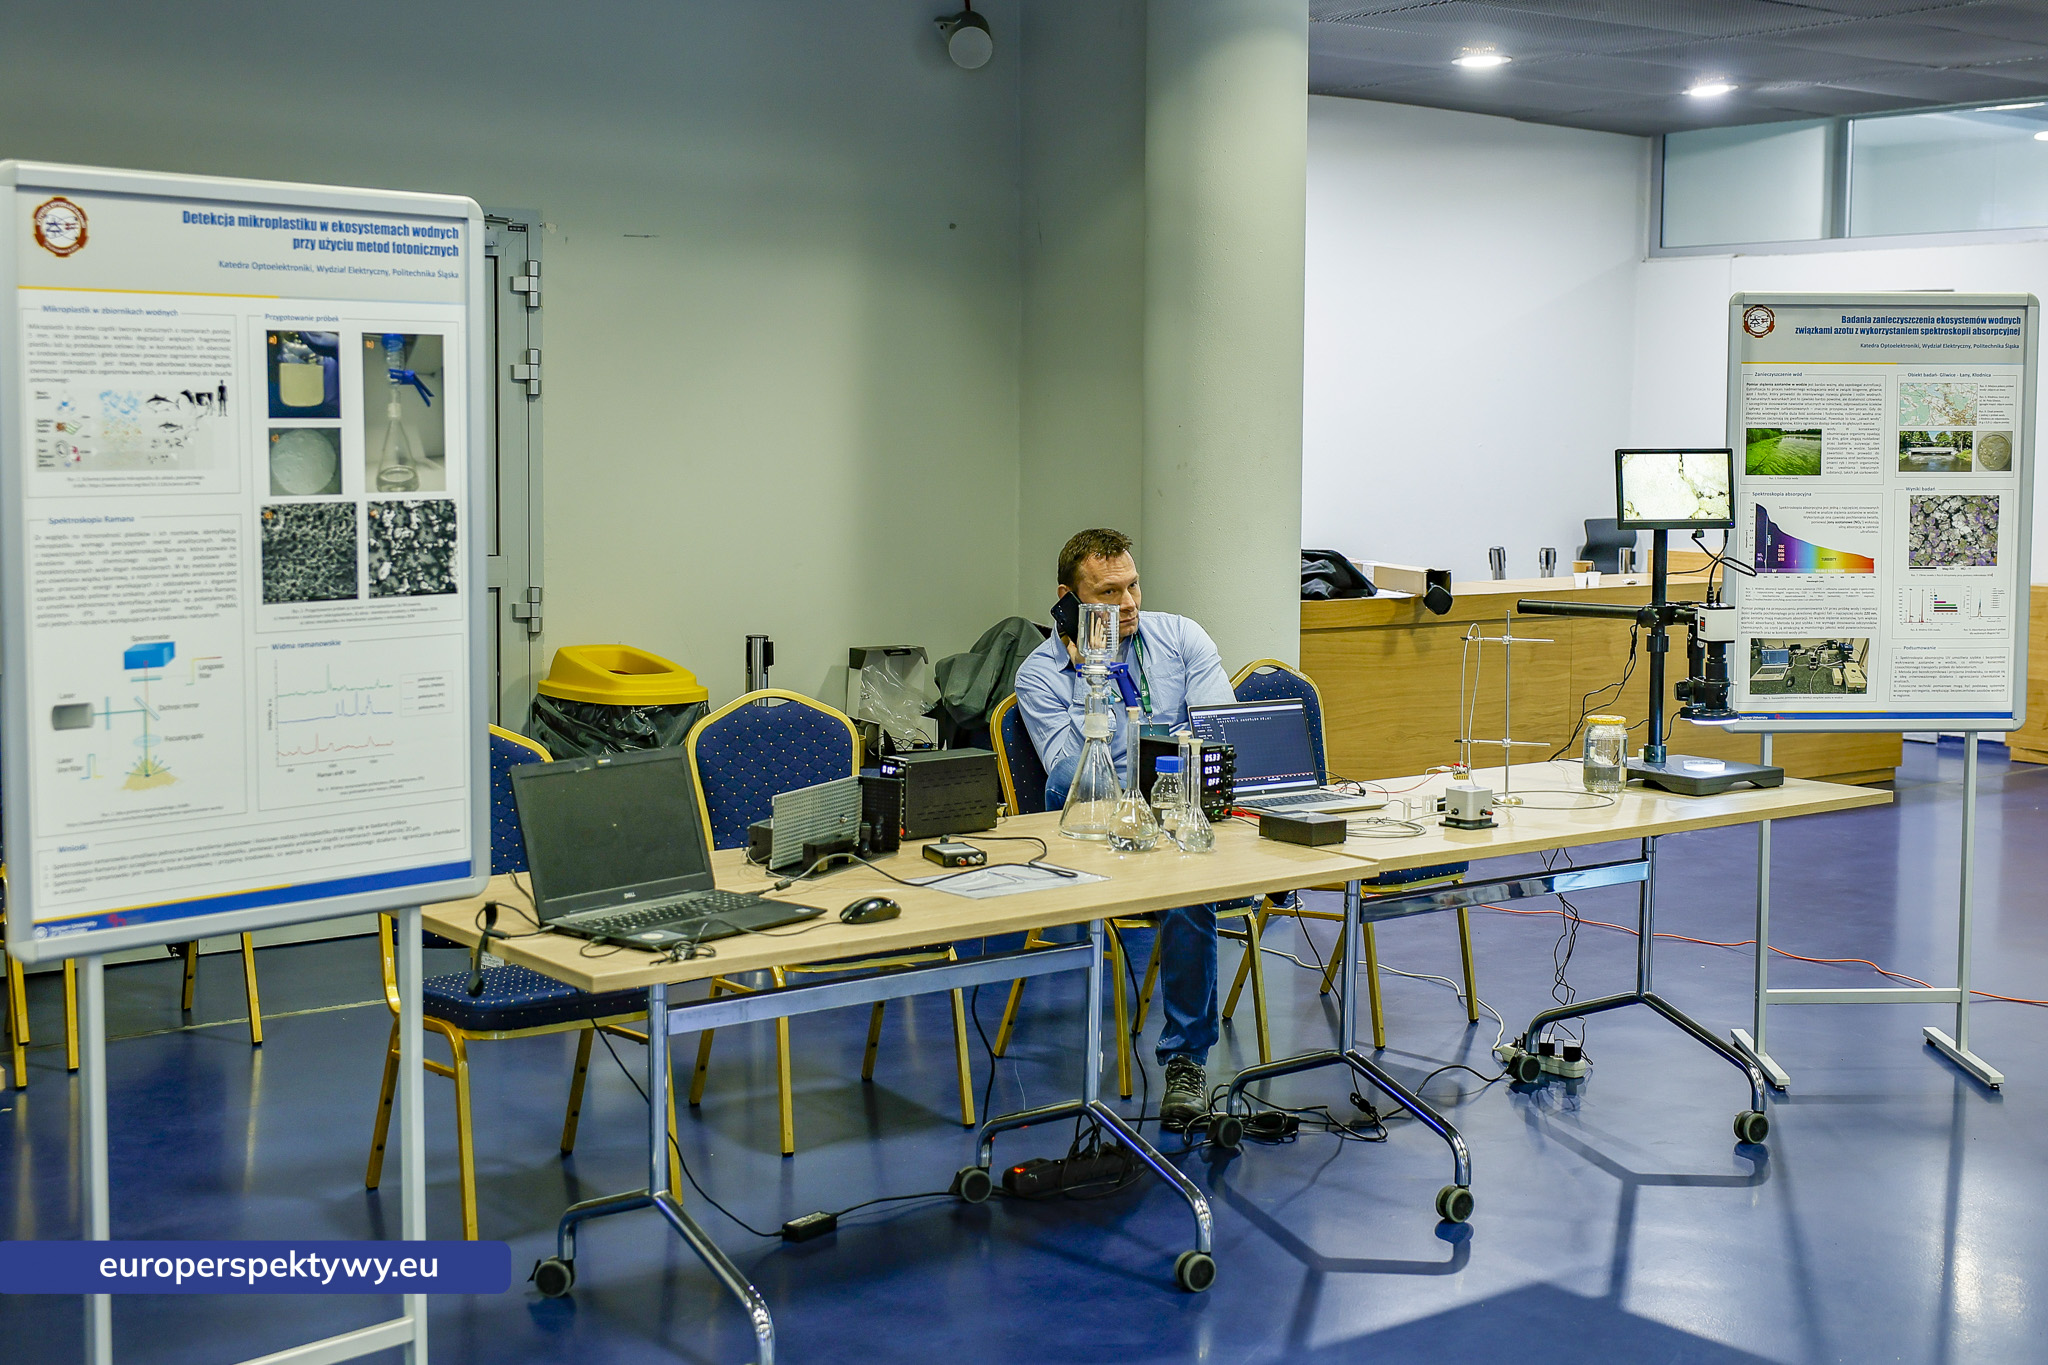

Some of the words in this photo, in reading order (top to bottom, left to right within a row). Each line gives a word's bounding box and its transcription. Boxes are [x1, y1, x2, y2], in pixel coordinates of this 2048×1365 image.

[182, 210, 235, 227] Detekcja
[238, 214, 317, 231] mikroplastiku
[320, 220, 328, 232] w
[332, 220, 410, 236] ekosystemach
[412, 226, 459, 240] wodnych
[292, 238, 316, 251] przy
[318, 238, 354, 252] użyciu
[356, 240, 390, 254] metod
[392, 242, 459, 258] fotonicznych
[219, 260, 249, 270] Katedra
[392, 268, 436, 278] Politechnika
[265, 313, 314, 322] Przygotowanie
[316, 315, 339, 323] próbek
[1842, 316, 1871, 324] Badania
[1873, 316, 1935, 326] zanieczyszczenia
[1936, 316, 1987, 326] ekosystemów
[1988, 316, 2021, 326] wodnych
[1795, 326, 1833, 336] związkami
[1860, 327, 1919, 336] wykorzystaniem
[1920, 327, 1971, 336] spektroskopii
[1972, 327, 2020, 336] absorpcyjnej
